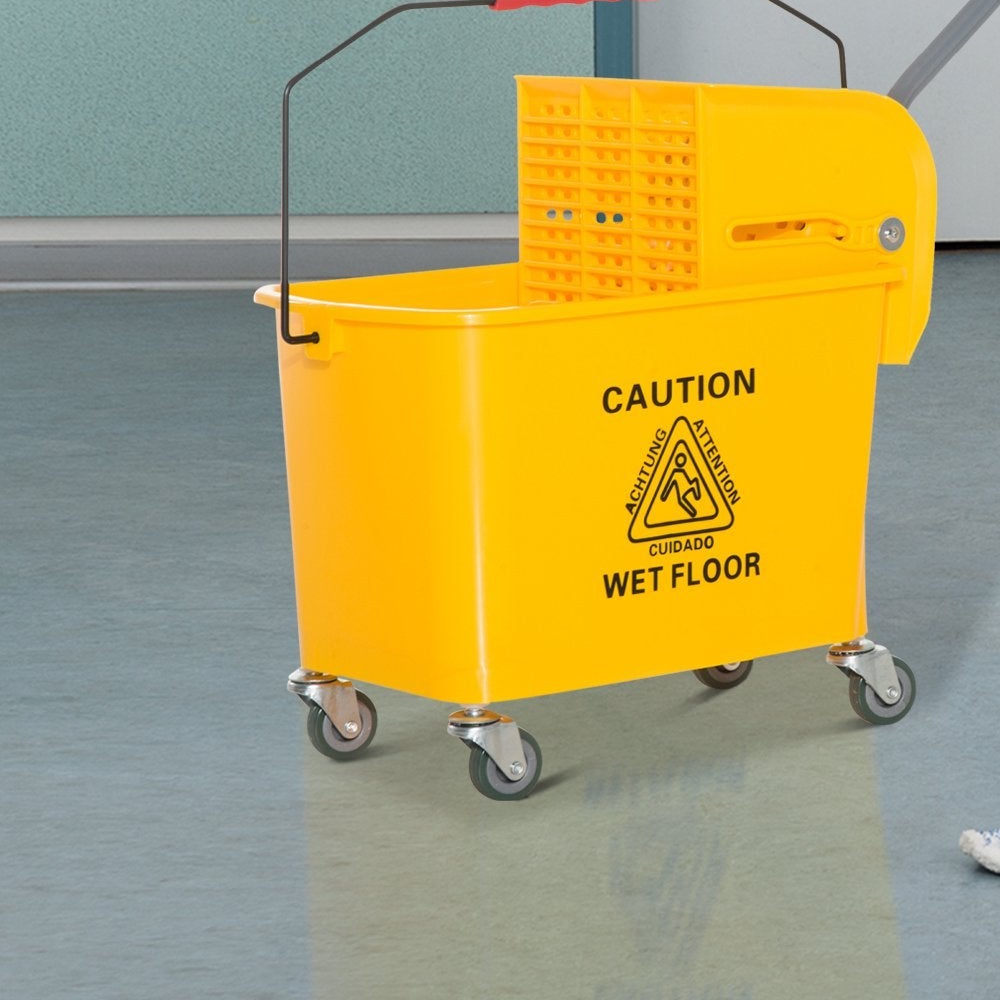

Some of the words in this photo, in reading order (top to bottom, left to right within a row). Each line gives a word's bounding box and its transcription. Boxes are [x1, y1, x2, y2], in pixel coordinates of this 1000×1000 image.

[602, 367, 755, 414] CAUTION
[625, 428, 667, 515] ACHTUNG
[693, 418, 741, 505] ATTENTION
[648, 535, 715, 557] CUIDADO
[603, 565, 664, 599] WET
[671, 552, 760, 589] FLOOR
